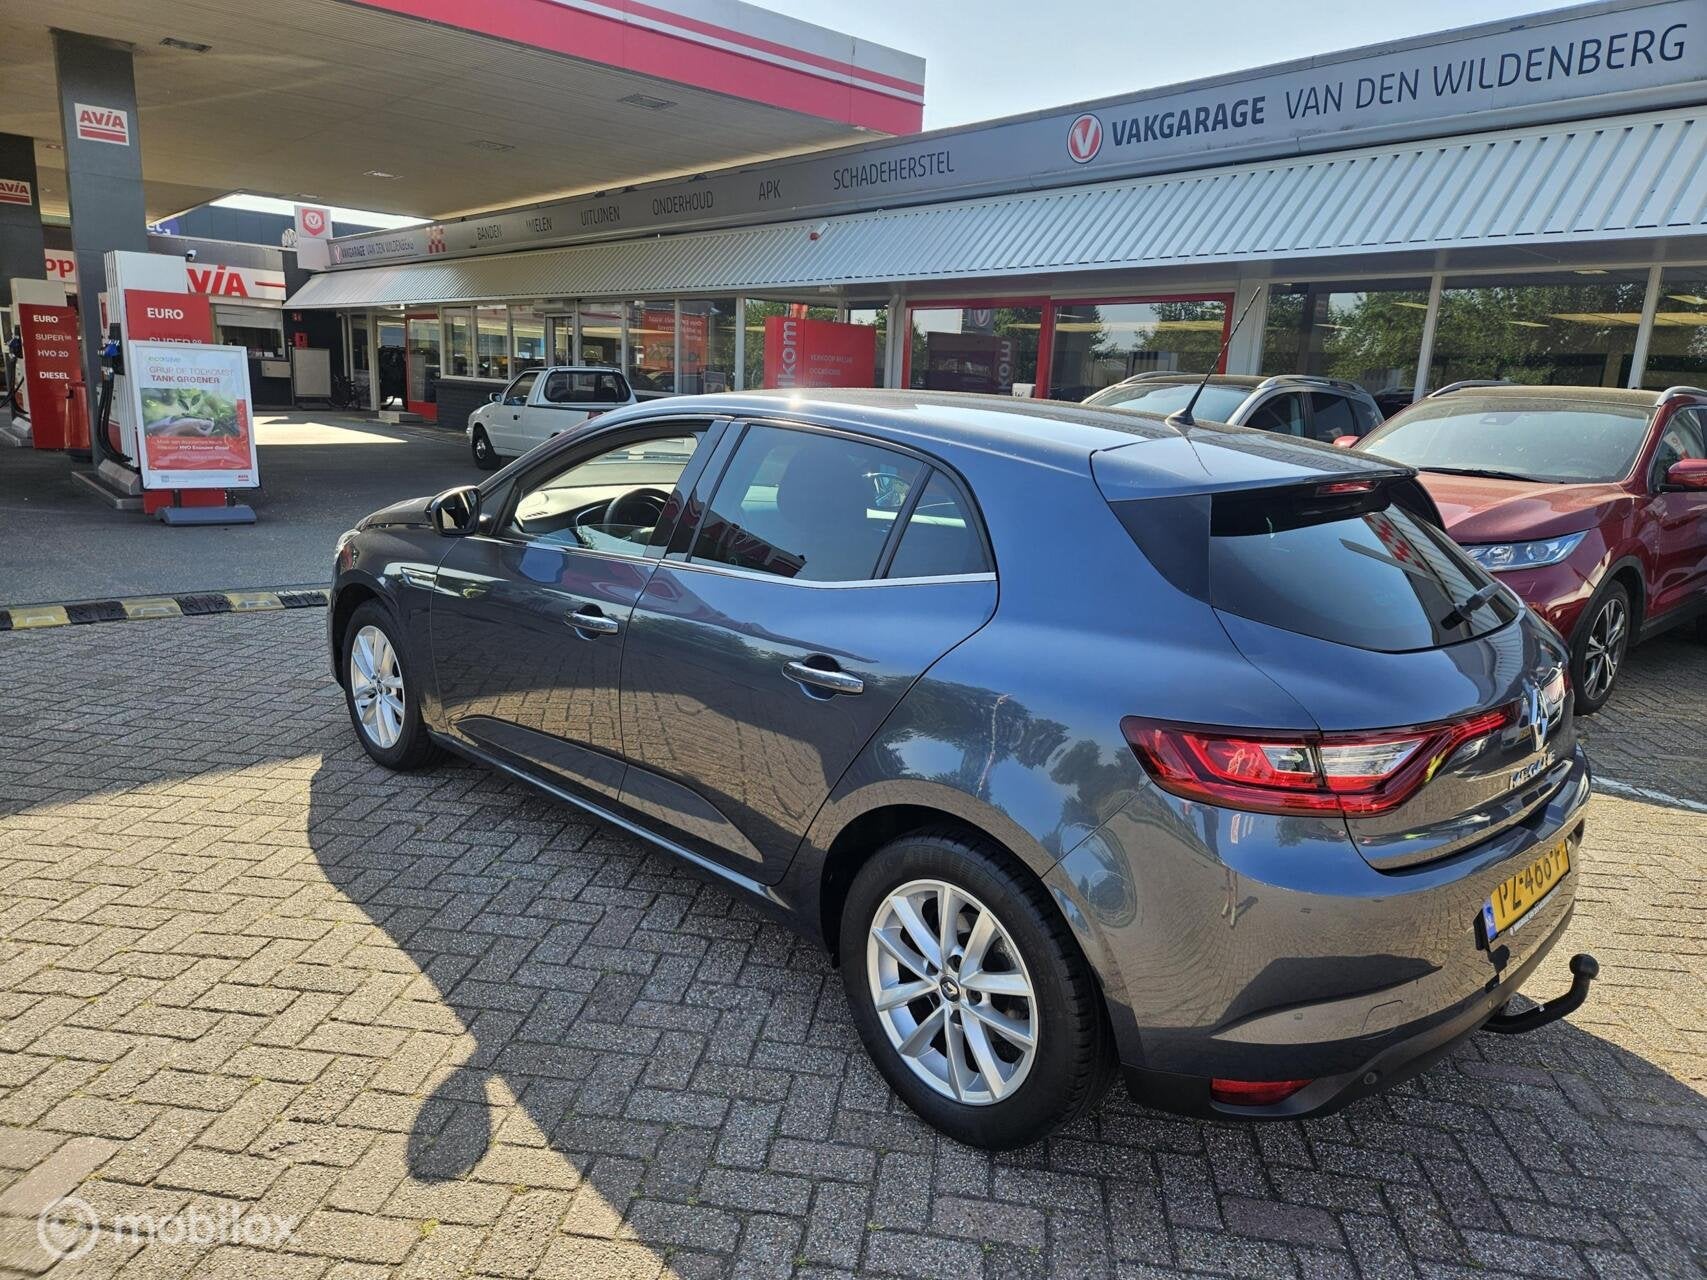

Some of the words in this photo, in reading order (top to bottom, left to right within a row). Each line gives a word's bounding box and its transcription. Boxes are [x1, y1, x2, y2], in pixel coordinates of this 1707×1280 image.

[1111, 95, 1266, 146] VAKGARAGE
[1285, 81, 1343, 120] VAN
[1355, 68, 1420, 109] DEN
[1432, 23, 1688, 97] WILDENBERG
[79, 110, 126, 129] AVIA
[476, 223, 502, 241] BANDEN
[652, 190, 714, 216] ONDERHOUD
[758, 178, 782, 201] APK
[832, 150, 955, 191] SCHADEHERSTEL
[186, 264, 249, 297] VIA
[33, 314, 59, 324] EURO
[147, 307, 184, 321] EURO
[35, 333, 64, 342] SUPER
[38, 350, 57, 358] HVO
[58, 350, 69, 358] 20
[40, 371, 69, 380] DIESEL
[151, 375, 175, 383] TANK
[176, 376, 221, 384] GROENER
